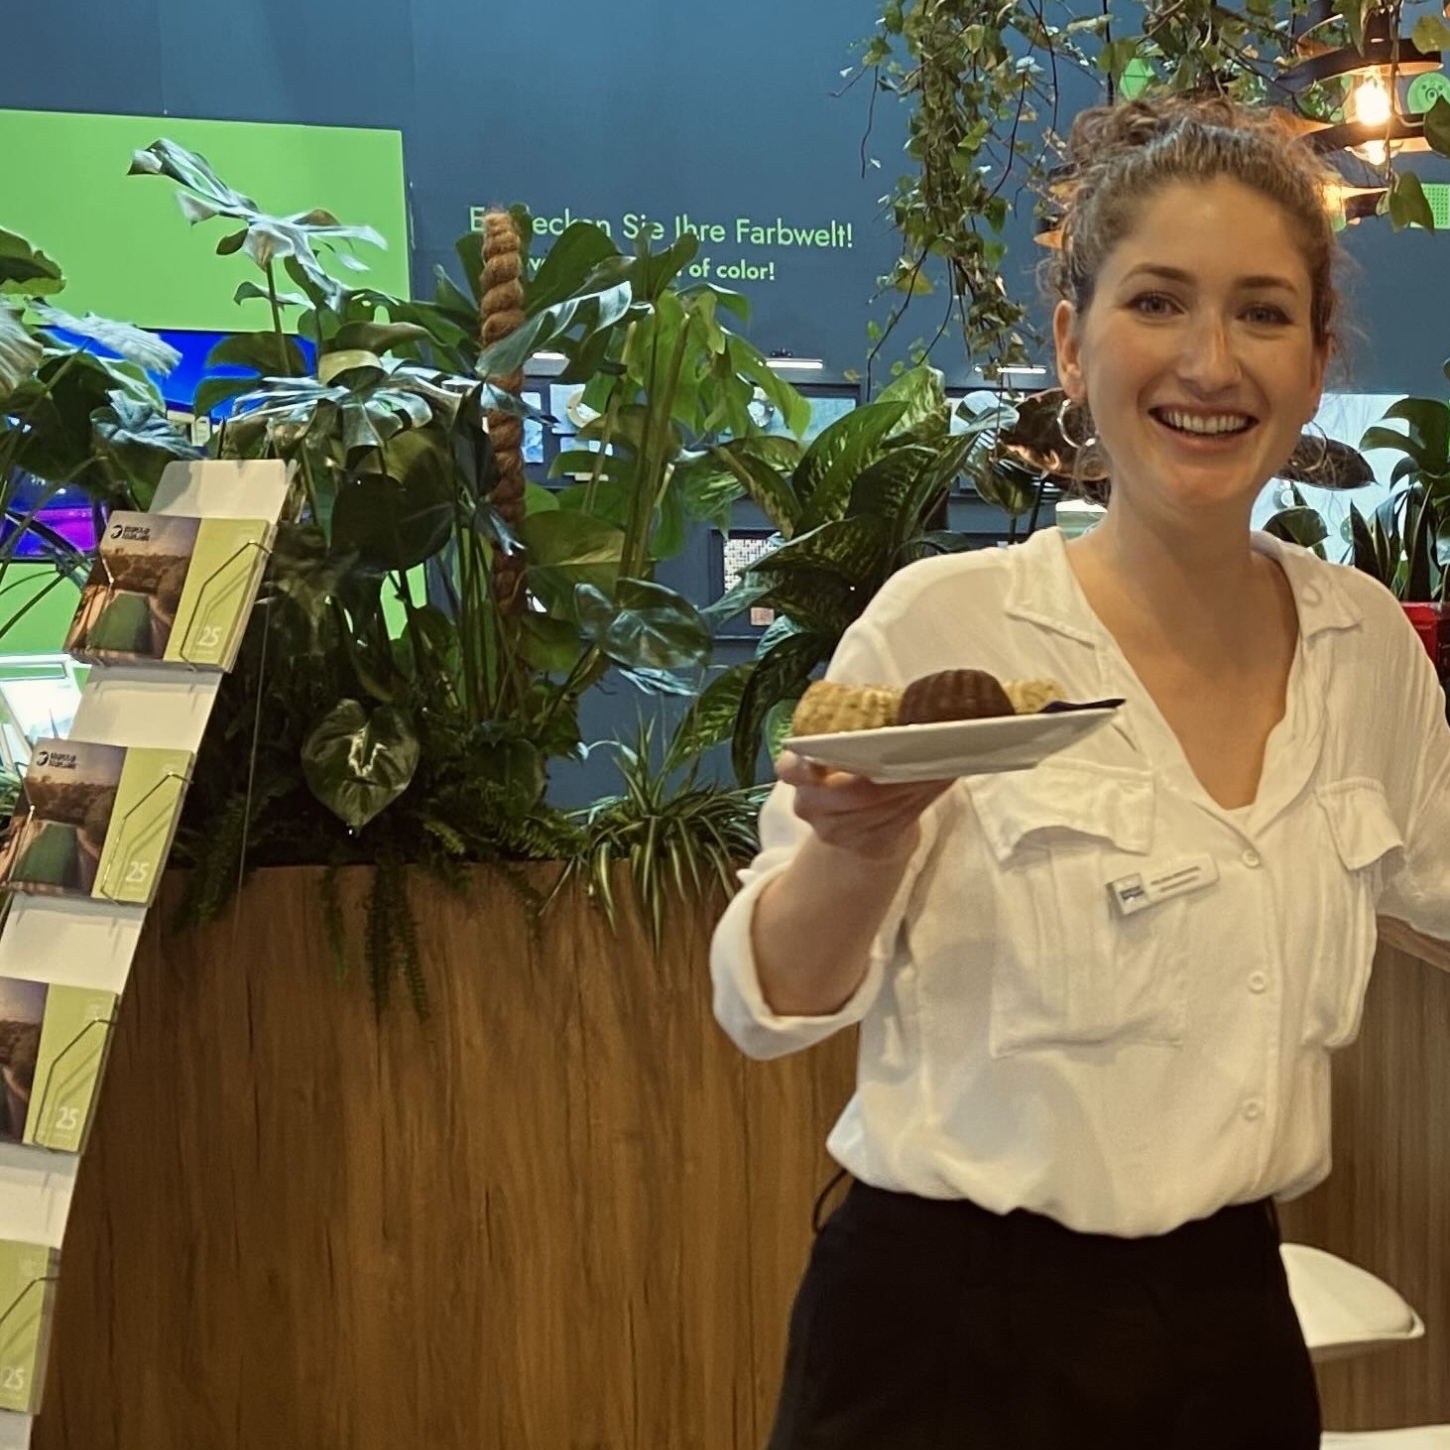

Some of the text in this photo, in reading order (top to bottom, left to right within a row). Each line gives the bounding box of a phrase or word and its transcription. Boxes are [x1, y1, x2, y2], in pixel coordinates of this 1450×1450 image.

[470, 206, 611, 238] Eeckn
[675, 214, 726, 243] Ihre
[736, 217, 853, 248] Farbwelt!
[688, 257, 711, 278] of
[716, 258, 775, 281] color!
[197, 625, 222, 647] 25
[125, 860, 150, 883] 25
[55, 1106, 80, 1130] 25
[3, 1367, 25, 1390] 25
